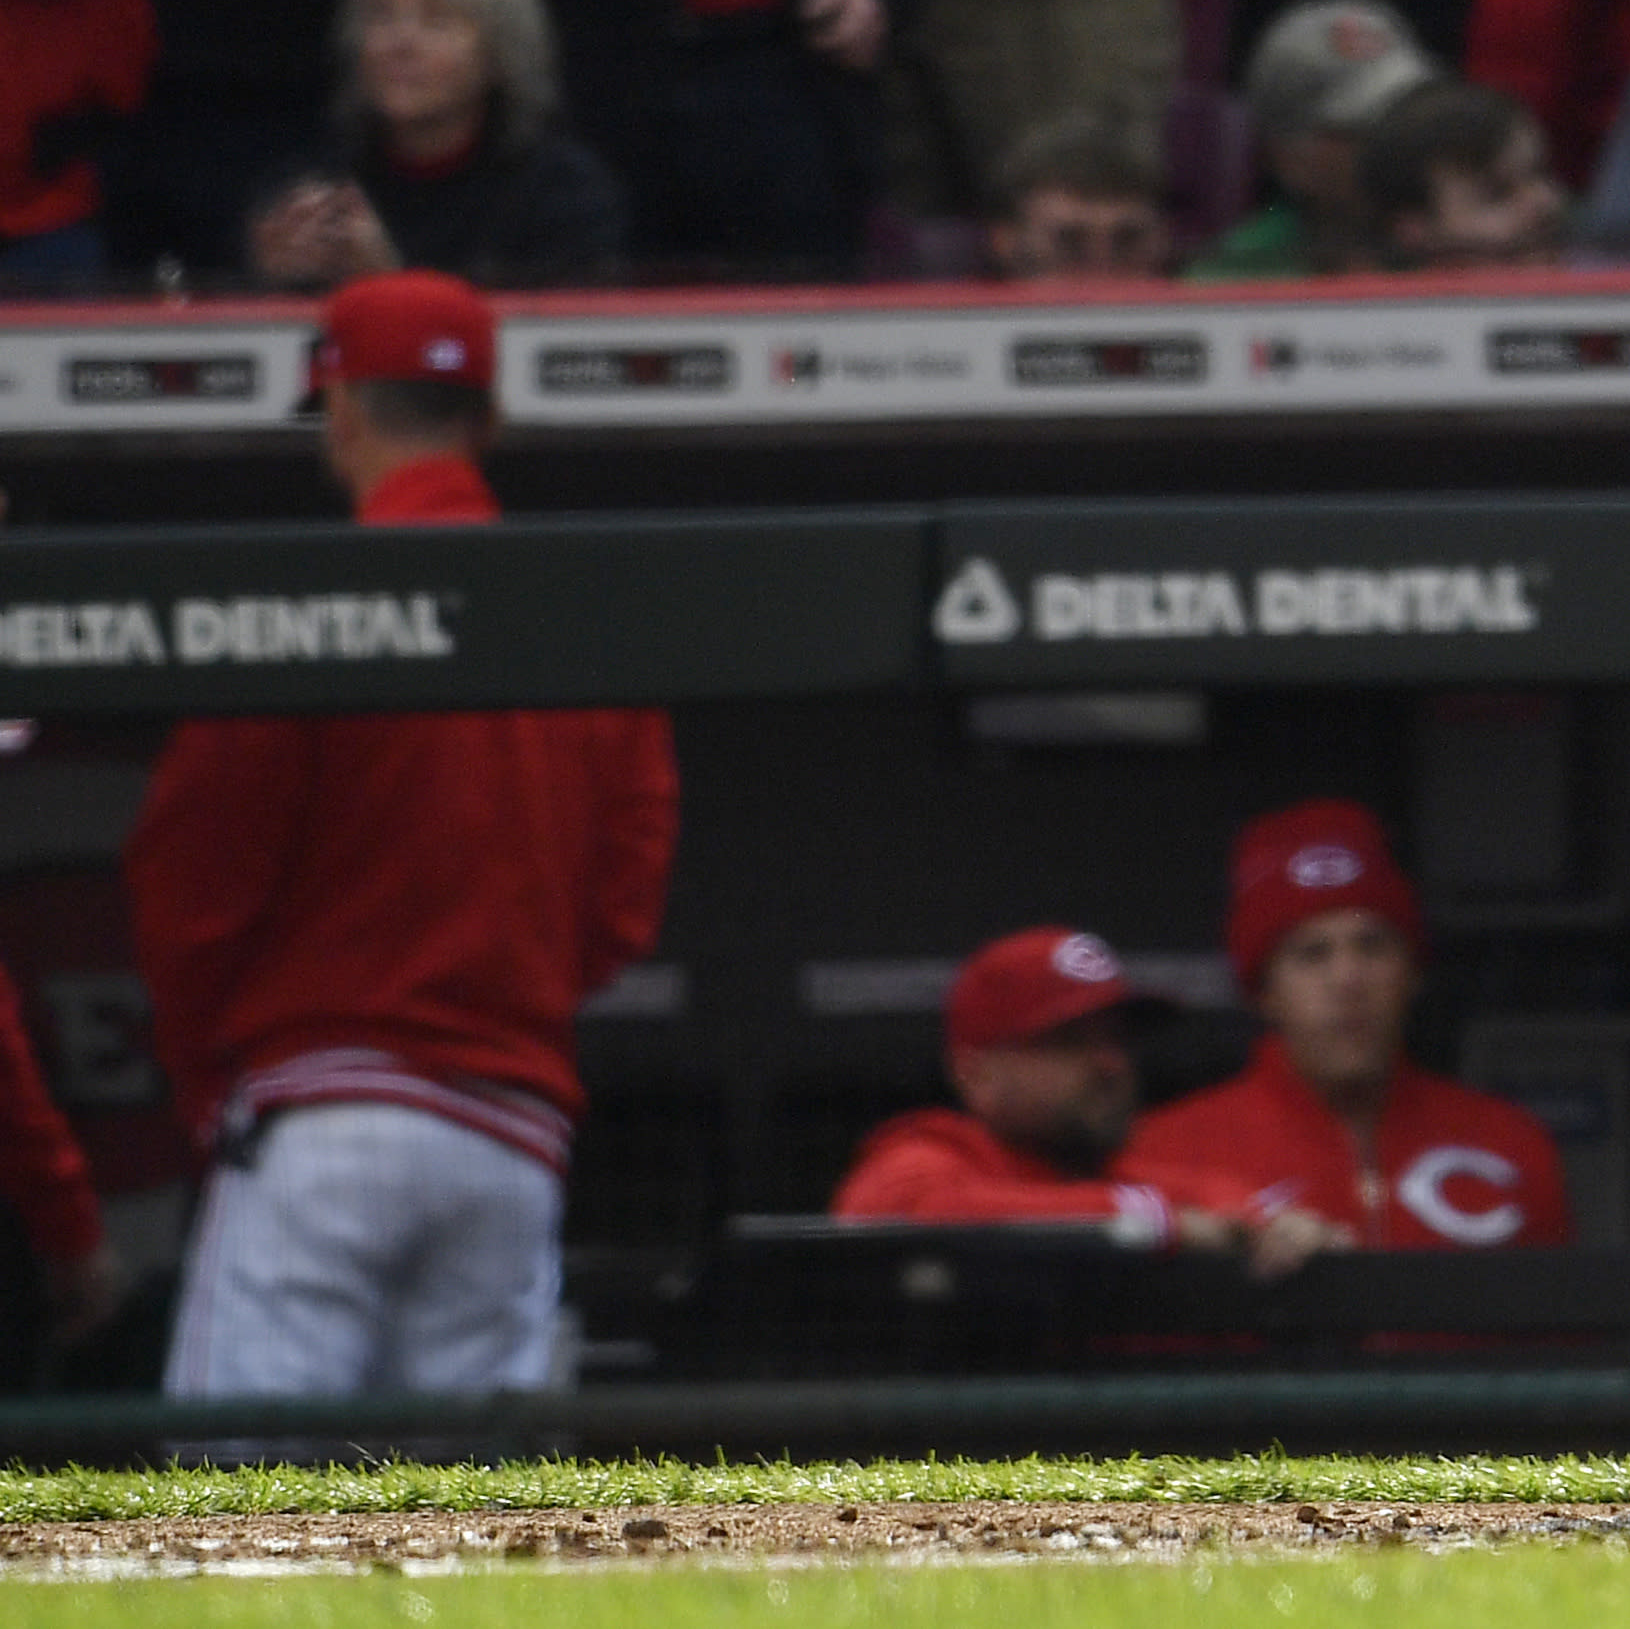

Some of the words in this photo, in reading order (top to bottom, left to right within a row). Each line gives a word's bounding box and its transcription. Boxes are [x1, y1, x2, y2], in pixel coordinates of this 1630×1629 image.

[172, 592, 456, 661] DENTAL
[1032, 576, 1246, 640] DELTA
[1258, 567, 1537, 634] DENTAL
[1397, 1145, 1526, 1246] C
